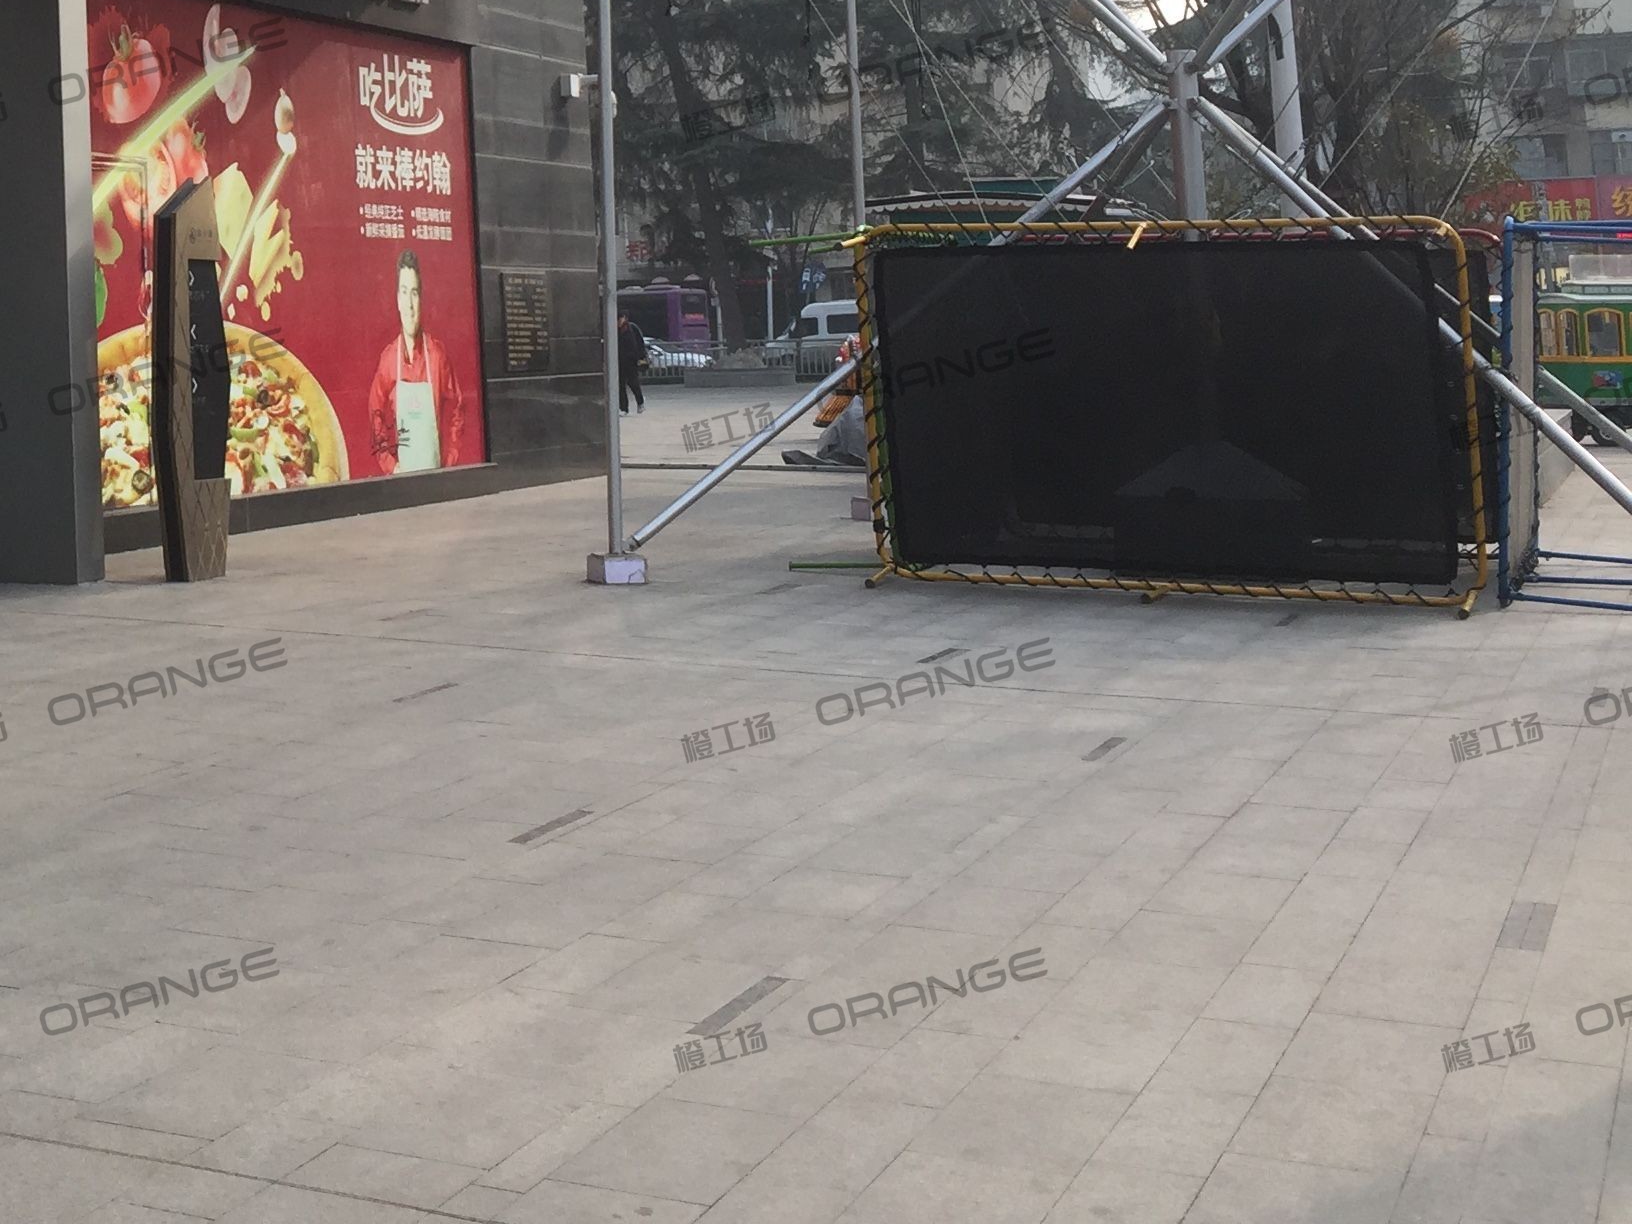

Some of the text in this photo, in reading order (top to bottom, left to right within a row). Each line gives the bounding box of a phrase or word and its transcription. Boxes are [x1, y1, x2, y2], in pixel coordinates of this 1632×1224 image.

[358, 53, 444, 135] 吃比萨
[355, 143, 452, 196] 就来棒约翰
